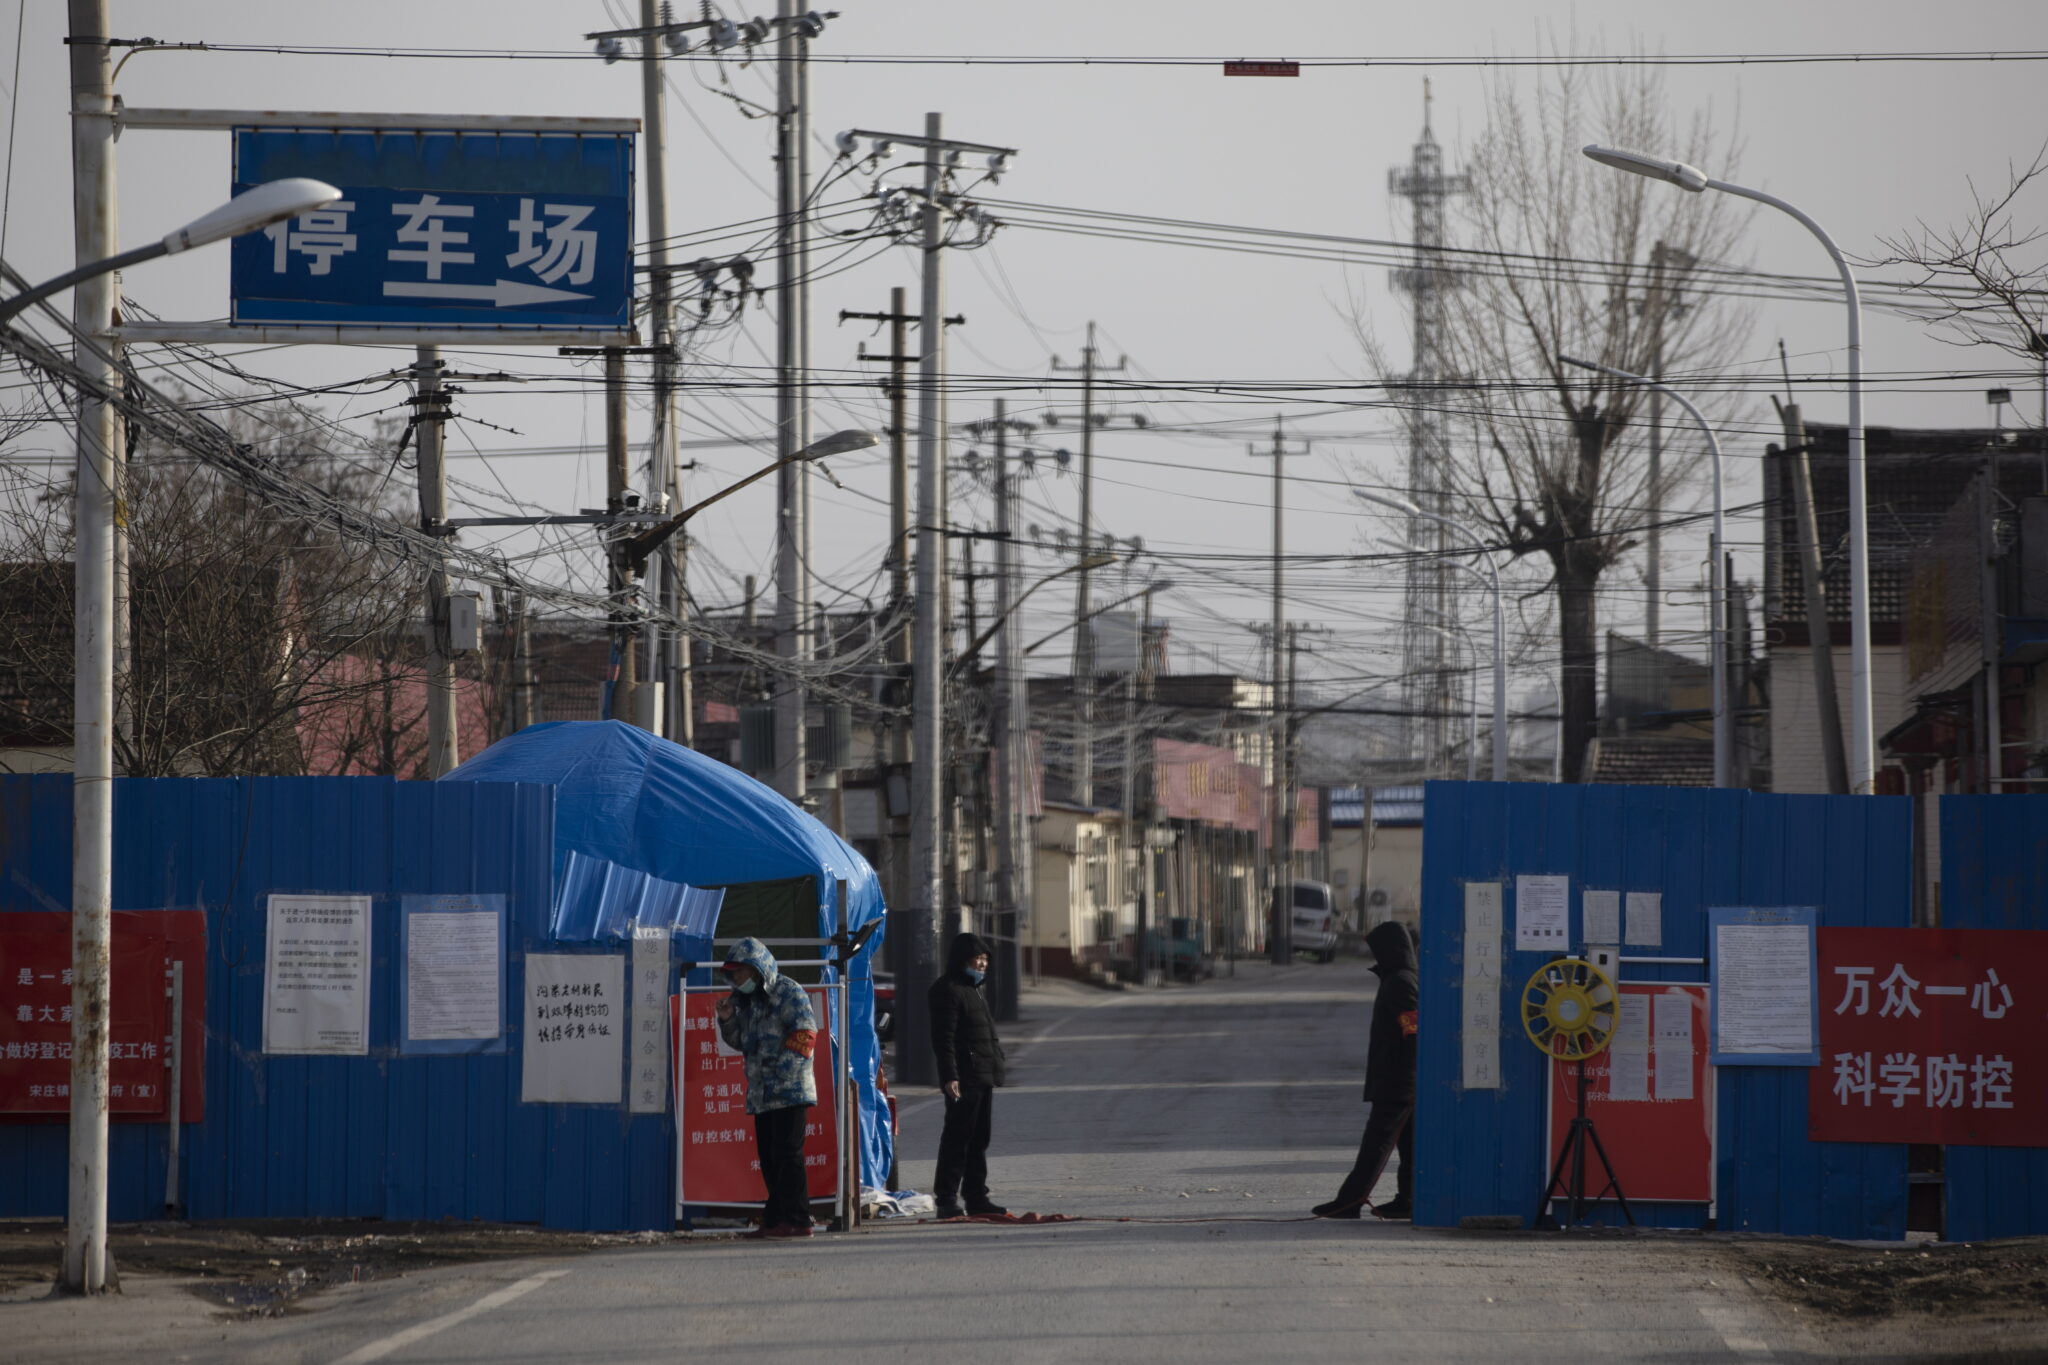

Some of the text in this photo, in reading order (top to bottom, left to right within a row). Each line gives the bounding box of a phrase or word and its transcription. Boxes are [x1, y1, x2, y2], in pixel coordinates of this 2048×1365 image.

[264, 194, 597, 286] 停车场
[1833, 963, 2014, 1019] 万众一心
[1832, 1051, 2014, 1109] 科学防控
